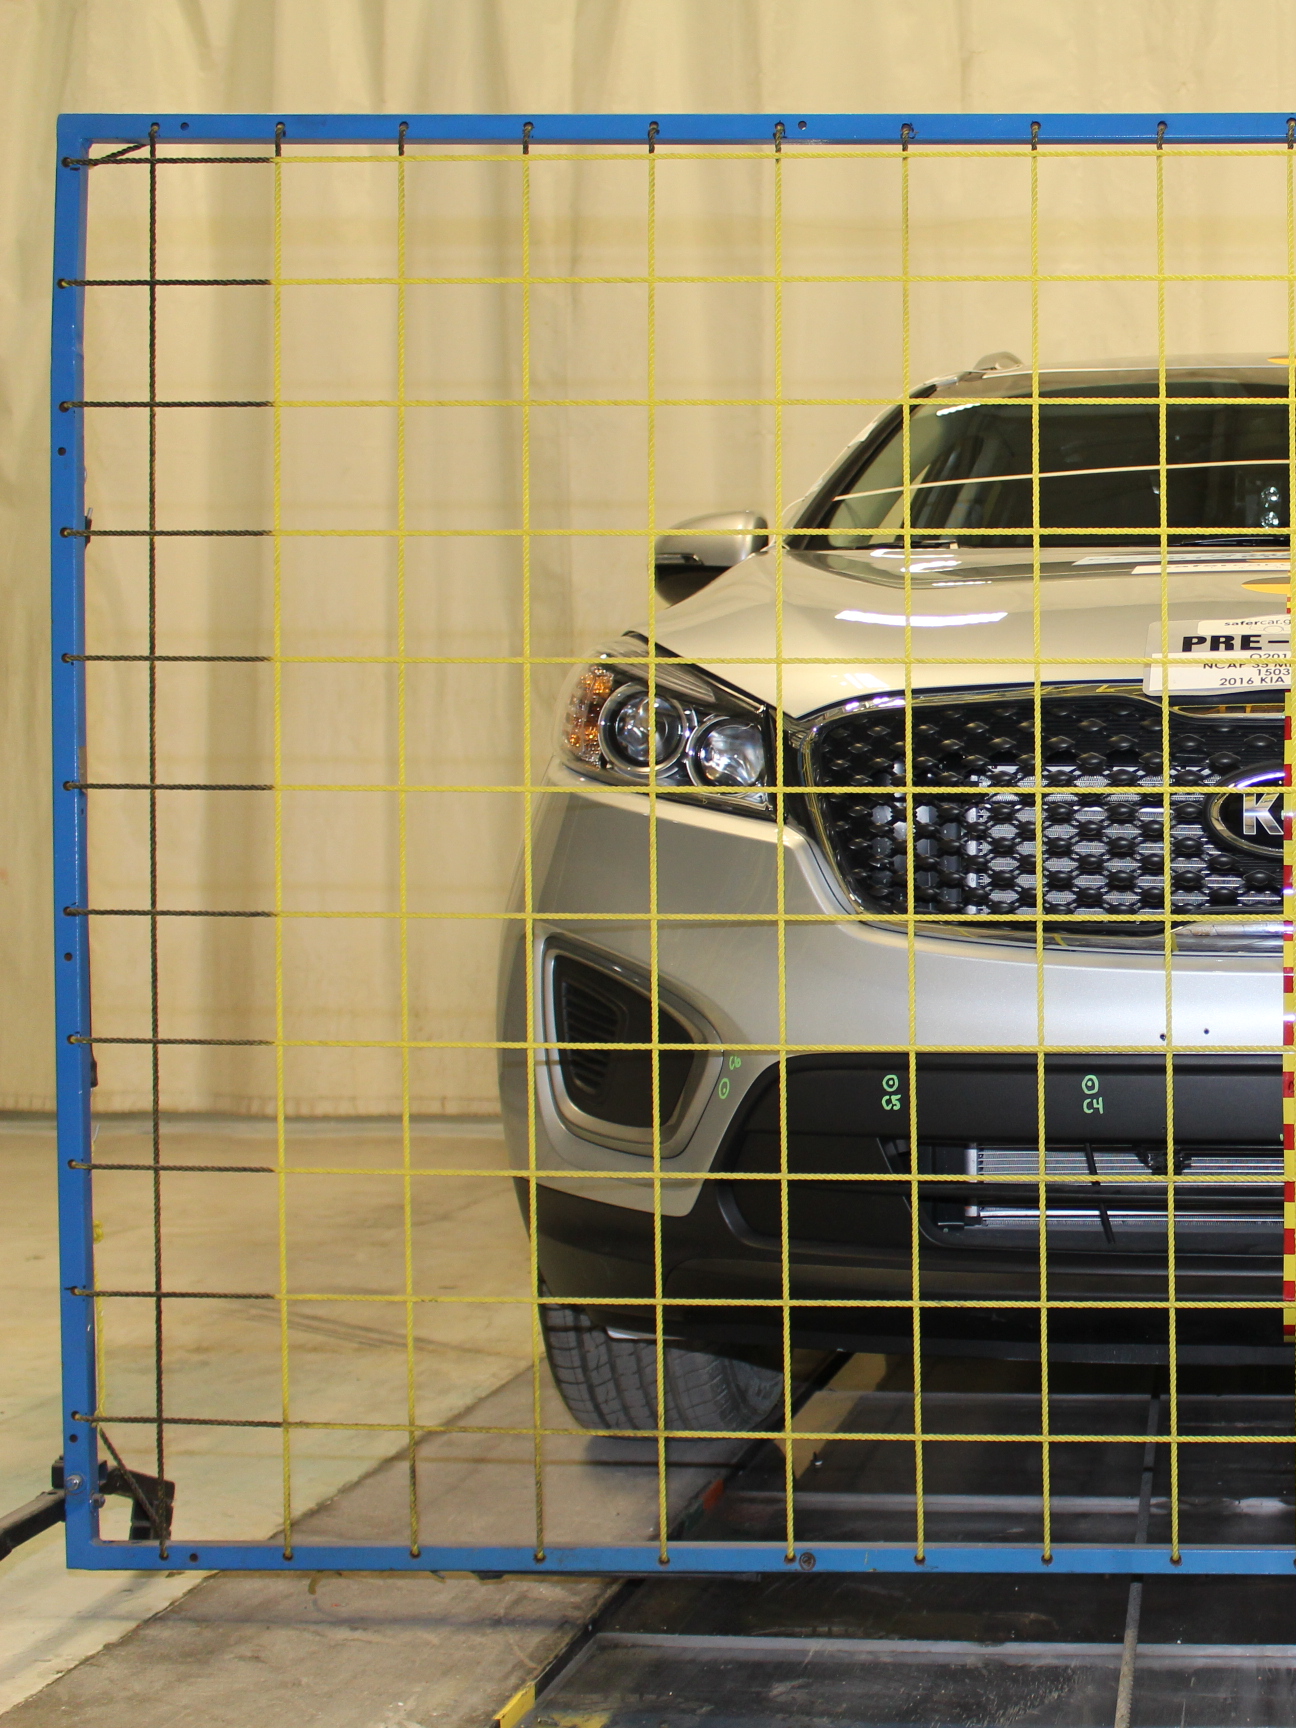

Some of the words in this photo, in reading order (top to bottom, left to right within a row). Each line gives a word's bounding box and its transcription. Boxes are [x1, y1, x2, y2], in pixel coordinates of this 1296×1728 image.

[1219, 677, 1254, 686] 2016
[1260, 676, 1285, 684] KIA
[881, 1094, 902, 1111] C5
[1082, 1096, 1104, 1115] C4
